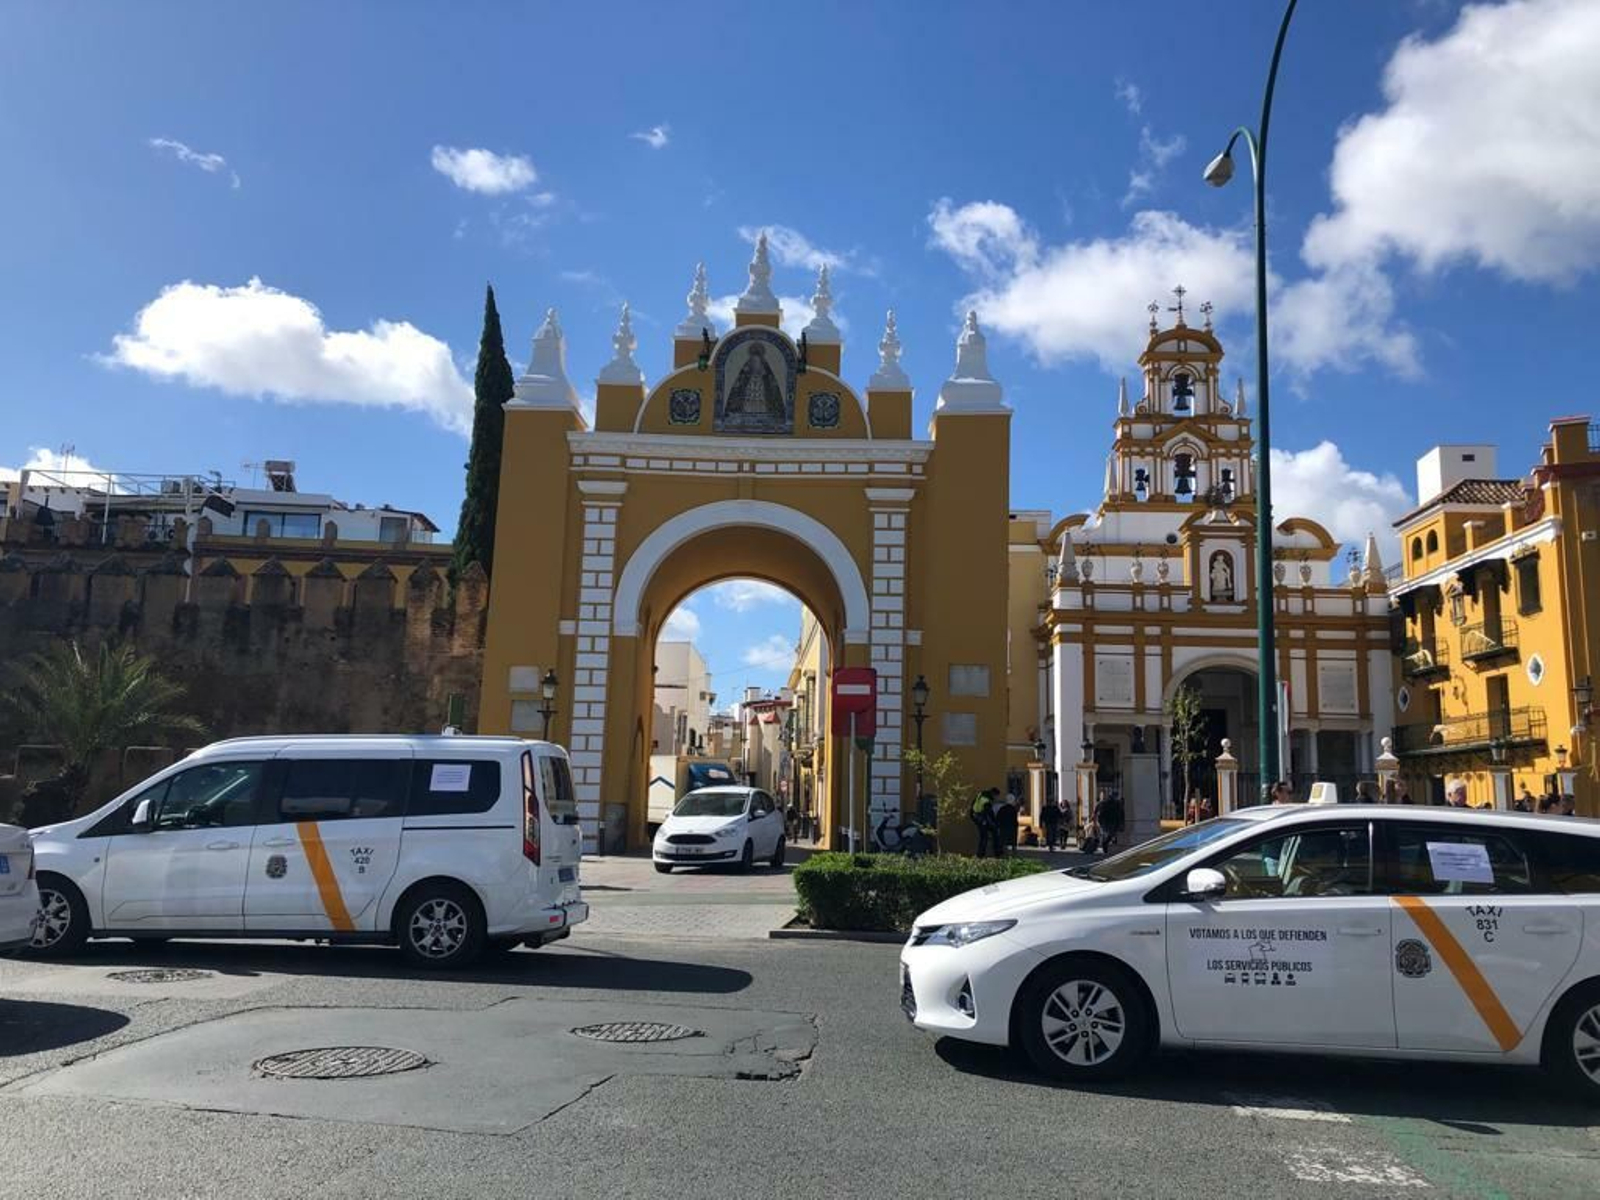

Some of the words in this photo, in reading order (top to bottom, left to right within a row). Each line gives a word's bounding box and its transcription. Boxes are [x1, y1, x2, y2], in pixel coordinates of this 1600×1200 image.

[350, 847, 374, 857] TAXI
[1465, 904, 1503, 917] TAXI
[1476, 919, 1498, 930] 831
[1189, 928, 1231, 939] VOTAMOS
[1234, 929, 1239, 939] A
[1241, 929, 1257, 940] LOS
[1259, 929, 1276, 940] QUE
[1278, 930, 1327, 941] DEFIENDEN
[1484, 931, 1494, 943] C
[1207, 959, 1223, 970] LOS
[1225, 959, 1269, 971] SERVICIOS
